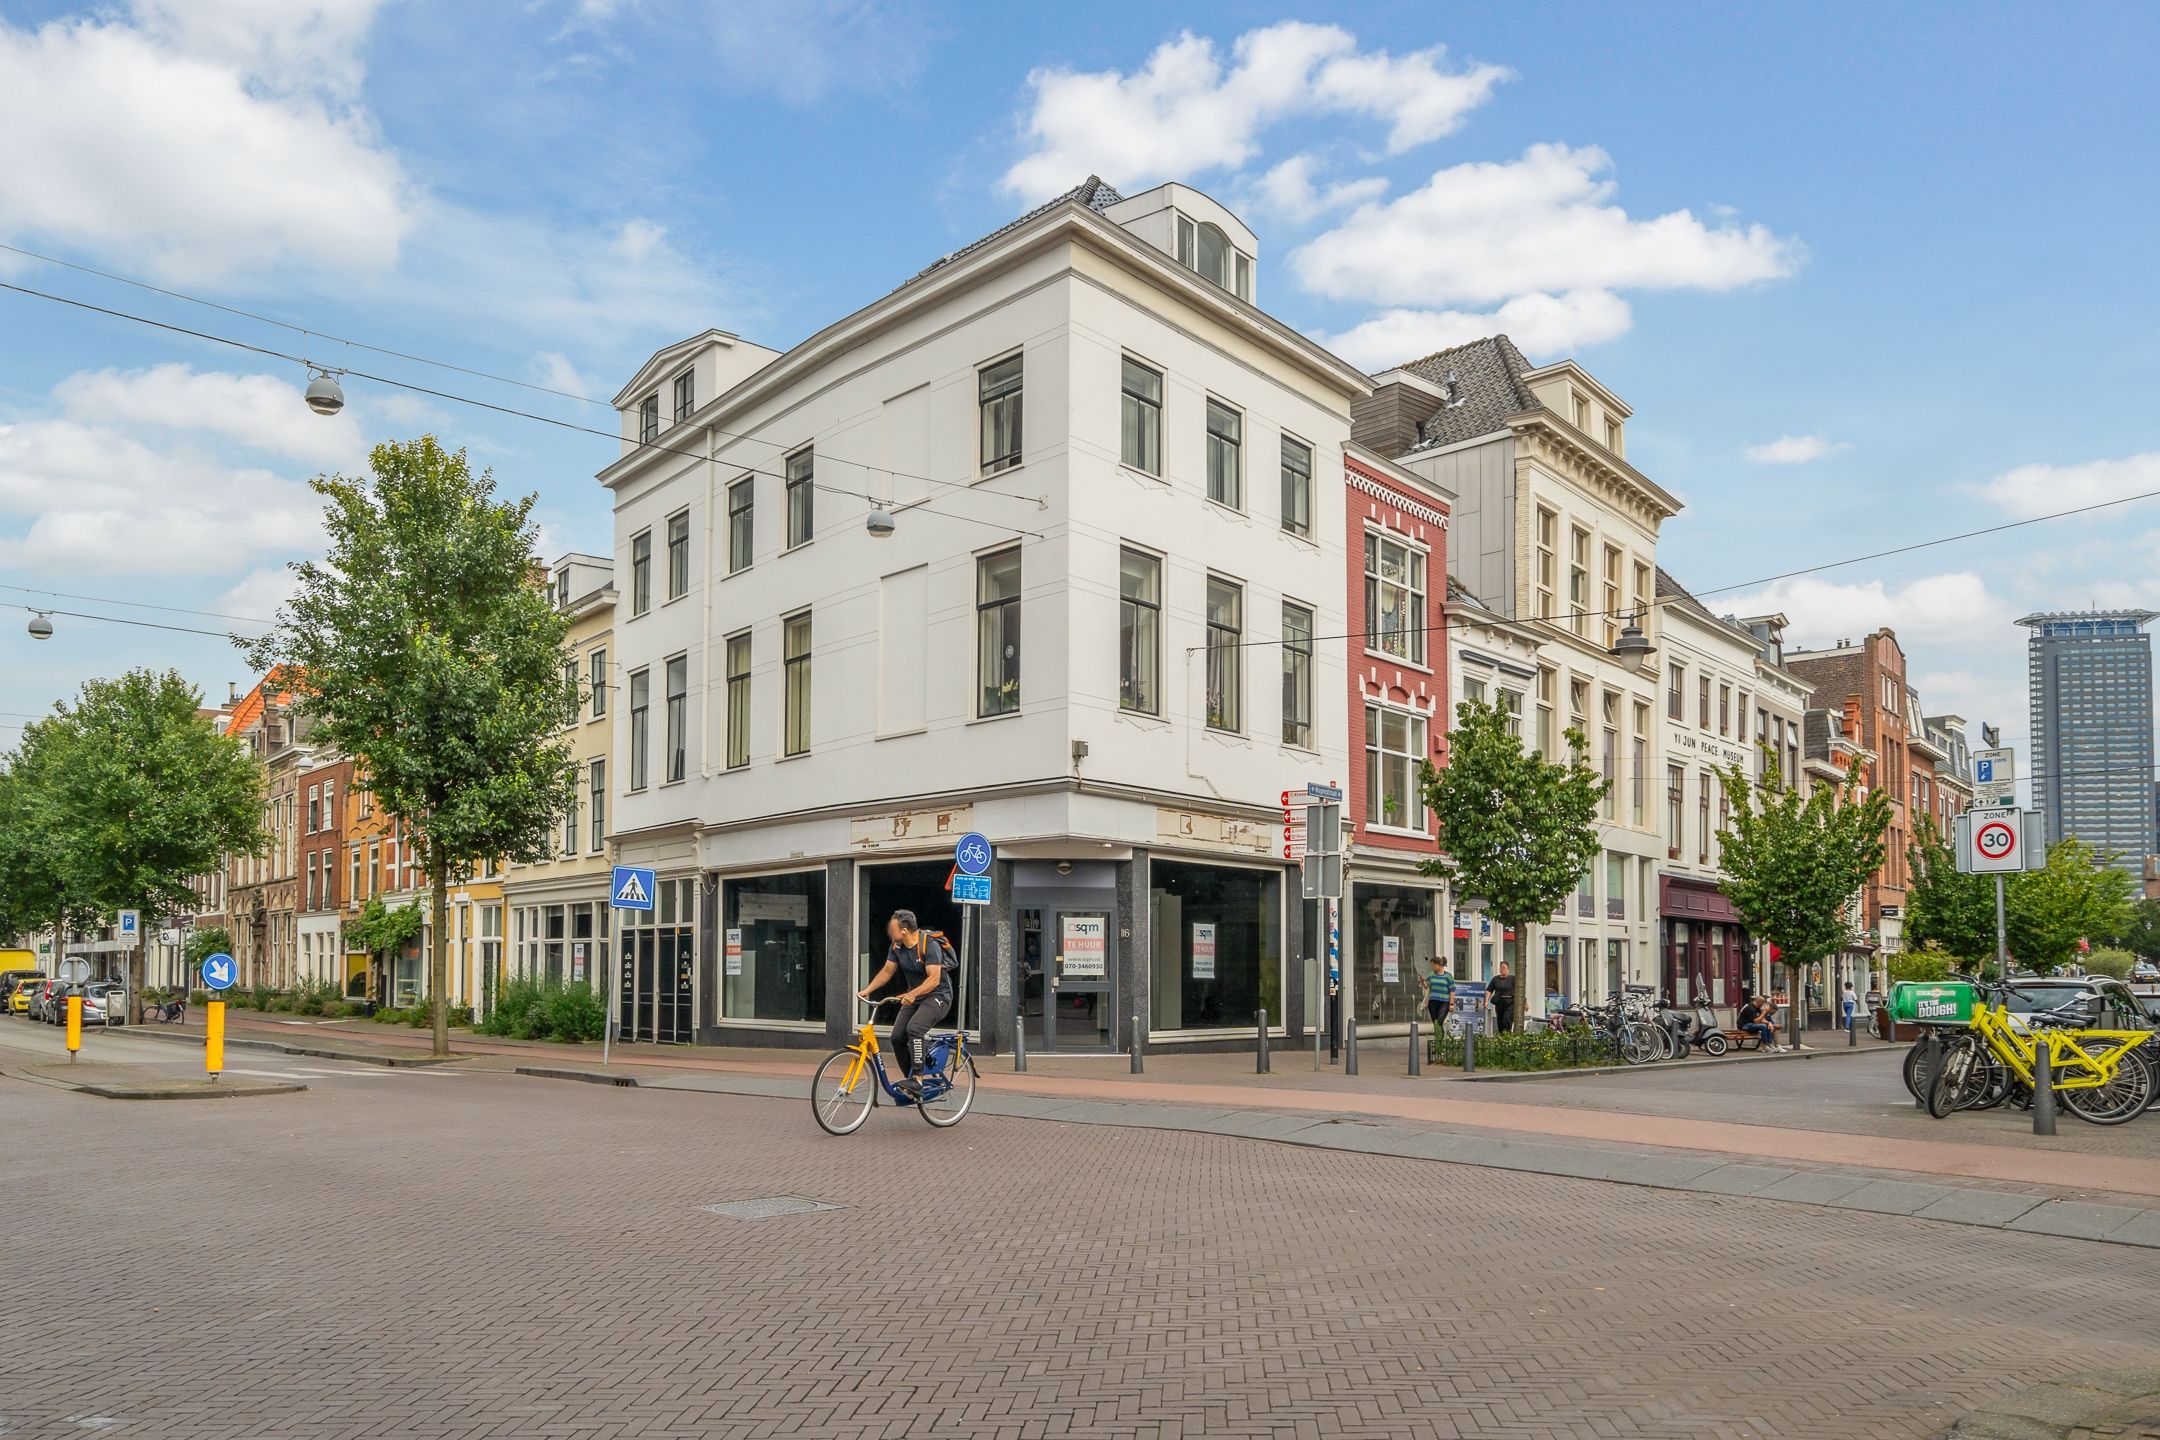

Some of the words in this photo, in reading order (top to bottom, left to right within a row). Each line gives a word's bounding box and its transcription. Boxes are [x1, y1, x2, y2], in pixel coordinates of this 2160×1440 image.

[1674, 732, 1681, 744] YI
[1683, 735, 1696, 748] JUN
[1701, 741, 1718, 756] PEACE
[1722, 748, 1744, 764] MUSEUM
[1983, 811, 2006, 819] ZONE
[1983, 832, 2009, 847] 30
[1075, 924, 1099, 935] sqm
[1066, 940, 1077, 949] TE
[1078, 940, 1102, 949] HUUR
[1918, 1003, 1957, 1017] DOUGH!
[913, 1039, 923, 1064] PUMA
